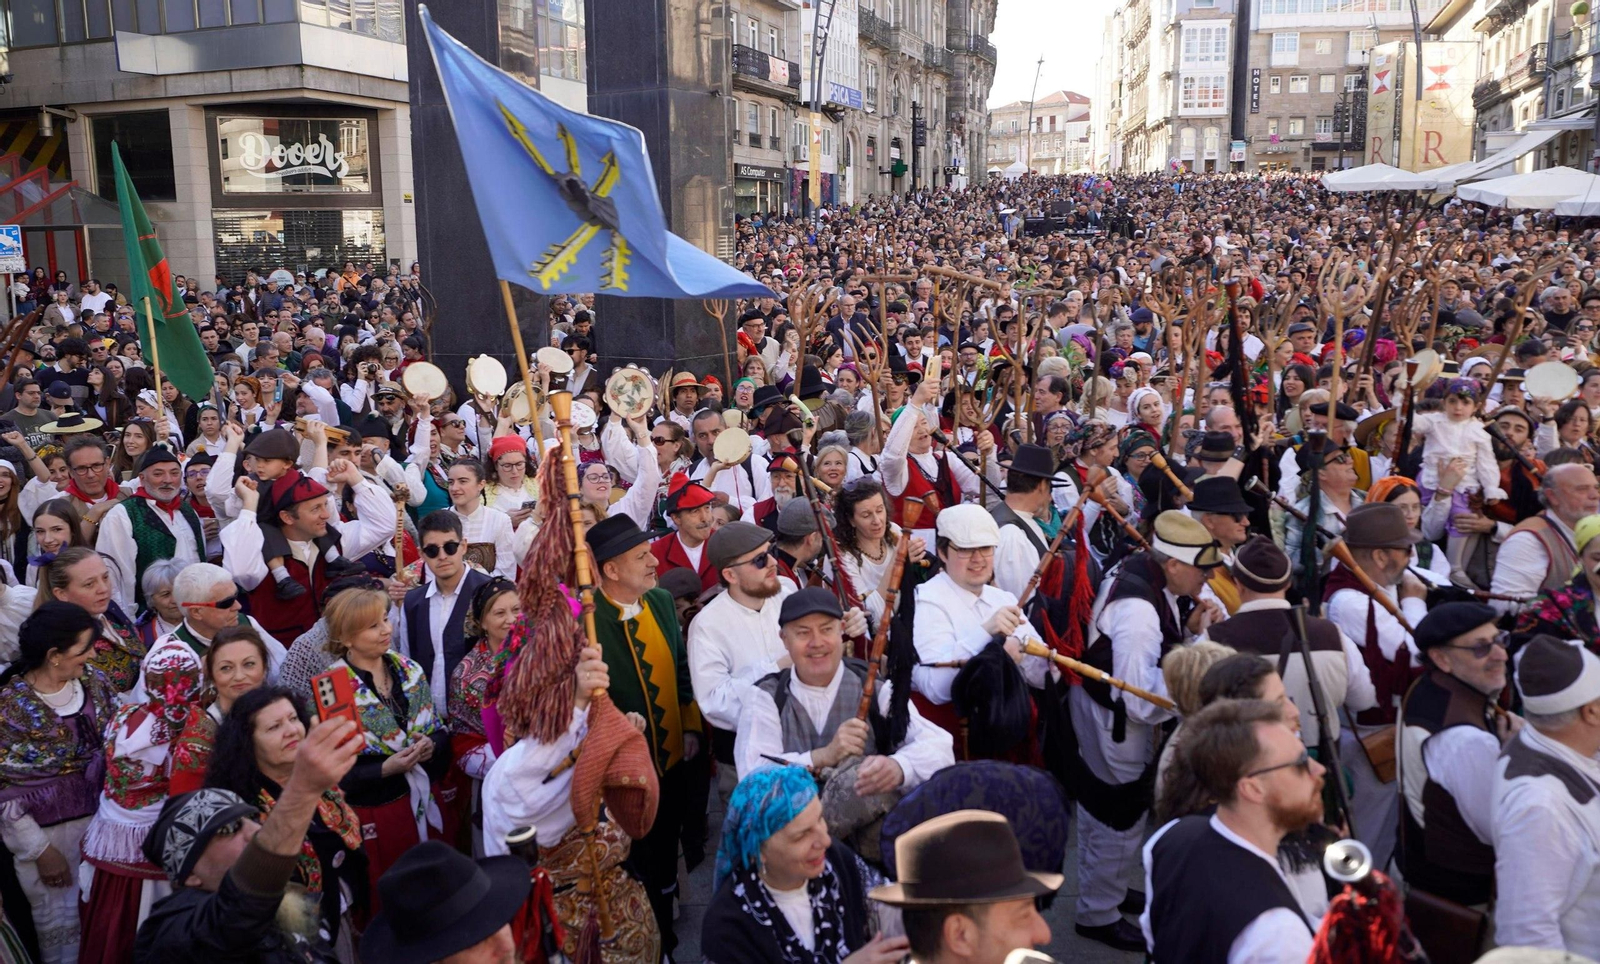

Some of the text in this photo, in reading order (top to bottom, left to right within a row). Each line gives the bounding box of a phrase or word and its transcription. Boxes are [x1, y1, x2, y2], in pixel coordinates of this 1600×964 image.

[238, 131, 350, 178] Dooers
[1371, 136, 1387, 165] R
[1421, 130, 1450, 165] R
[741, 166, 747, 176] AS
[747, 166, 766, 178] Computer
